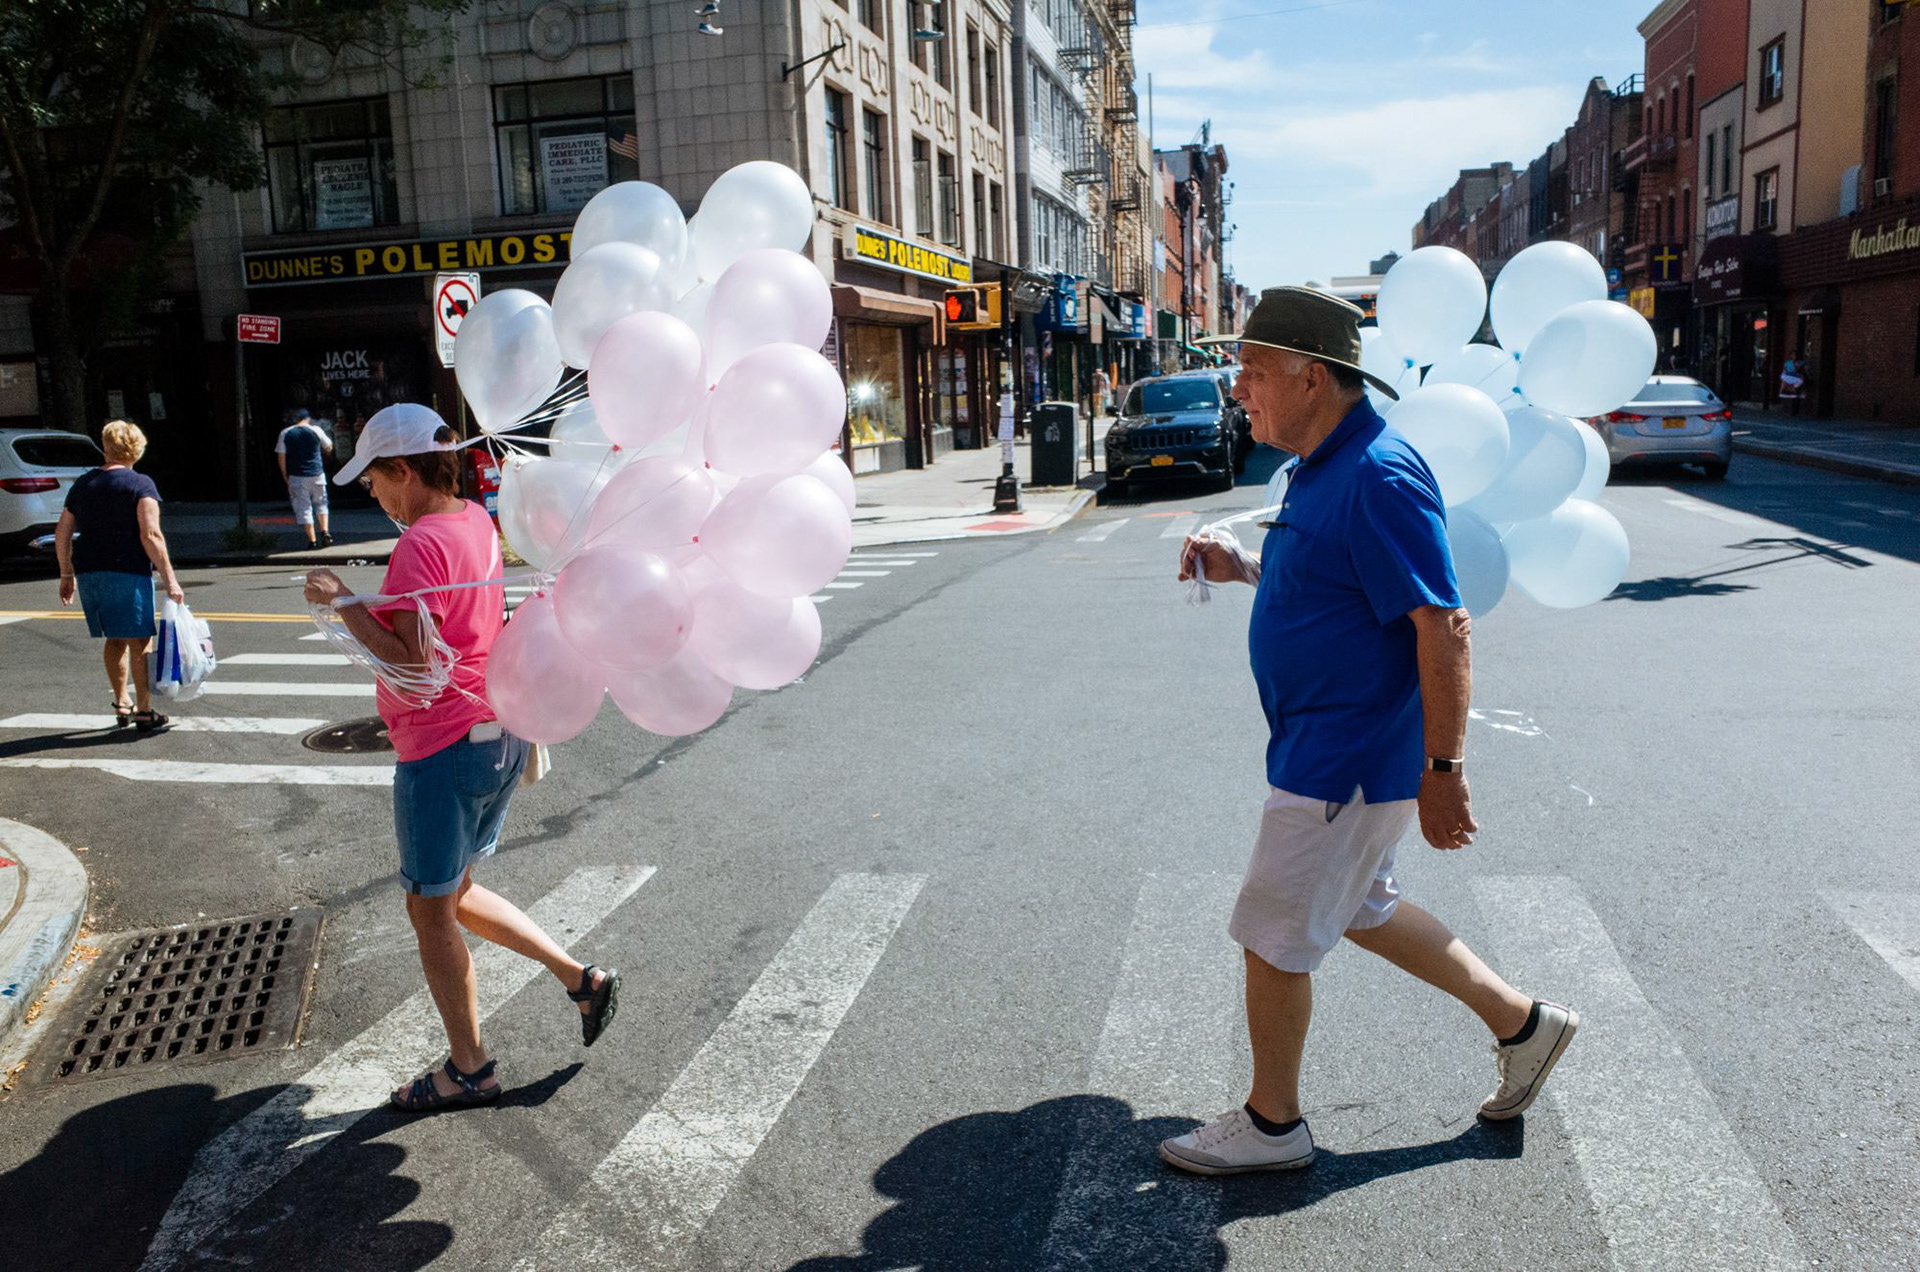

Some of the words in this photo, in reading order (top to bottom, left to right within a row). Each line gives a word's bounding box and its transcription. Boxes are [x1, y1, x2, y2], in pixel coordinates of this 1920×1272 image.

[549, 139, 600, 151] PEDIATRIC
[547, 147, 603, 159] IMMEDIATE
[579, 155, 604, 164] PLLC
[888, 239, 950, 278] POLEMOST
[250, 256, 344, 280] DUNNE'S
[321, 349, 369, 370] JACK
[347, 369, 371, 379] HERE
